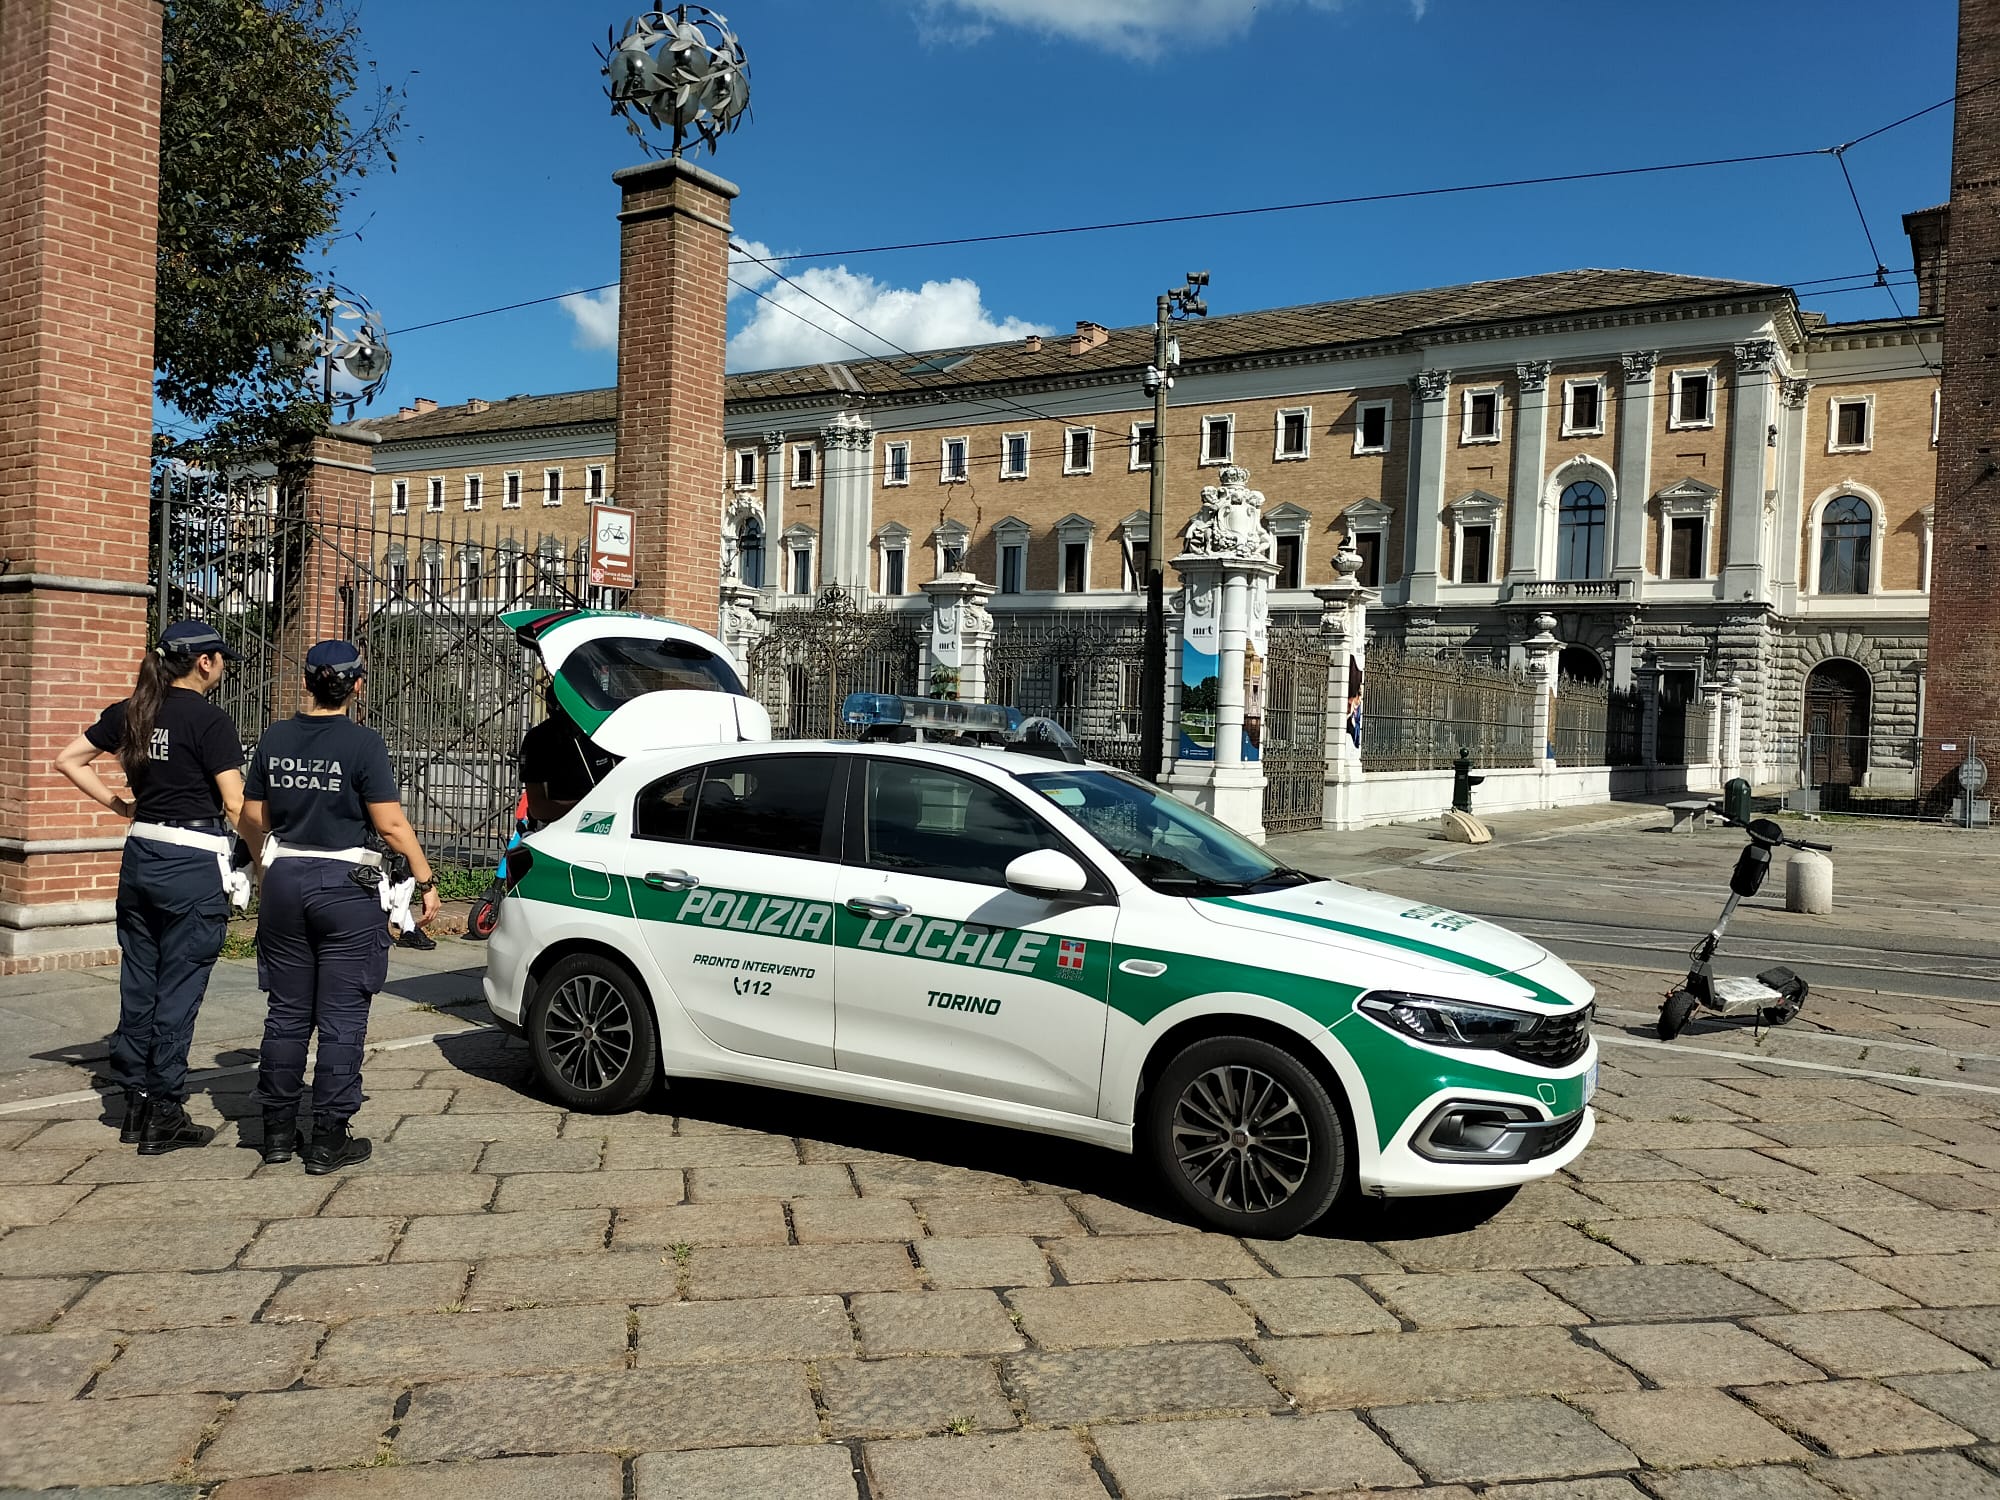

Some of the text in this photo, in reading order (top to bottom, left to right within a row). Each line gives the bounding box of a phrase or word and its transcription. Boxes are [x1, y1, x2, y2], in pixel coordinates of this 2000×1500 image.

[1192, 625, 1213, 635] mrt
[939, 641, 956, 650] mrt
[269, 757, 343, 776] POLIZIA
[593, 823, 611, 834] 005
[676, 889, 1050, 973] POLIZIA LOCALE
[692, 954, 815, 979] PRONTO INTERVENTO
[742, 979, 772, 996] 112
[927, 990, 1001, 1015] TORINO
